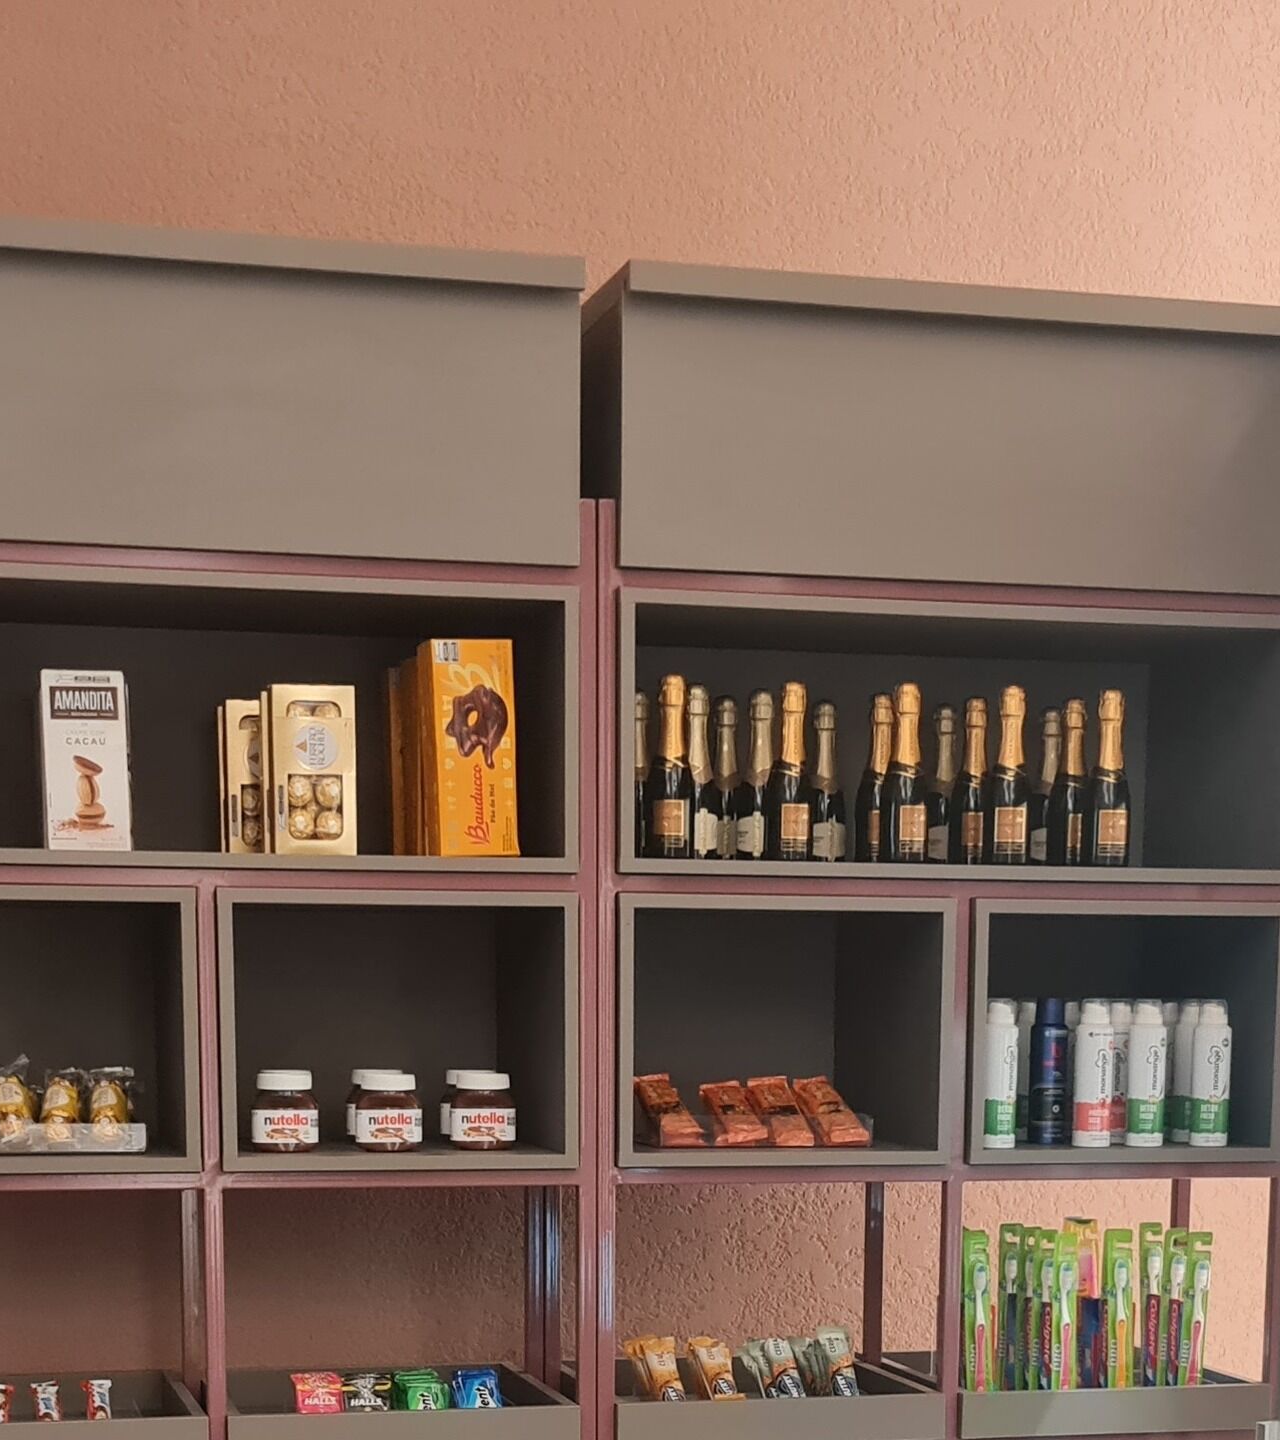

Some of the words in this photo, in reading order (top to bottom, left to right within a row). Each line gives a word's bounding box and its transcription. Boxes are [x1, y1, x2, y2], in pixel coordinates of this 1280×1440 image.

[54, 690, 114, 711] AMANDITA
[65, 737, 107, 746] CACAU
[464, 764, 491, 846] Bauducco
[264, 1112, 309, 1126] nutella
[369, 1112, 412, 1126] nutella
[461, 1112, 505, 1126] nutella
[304, 1396, 337, 1406] HALLS
[351, 1397, 383, 1407] HALLS
